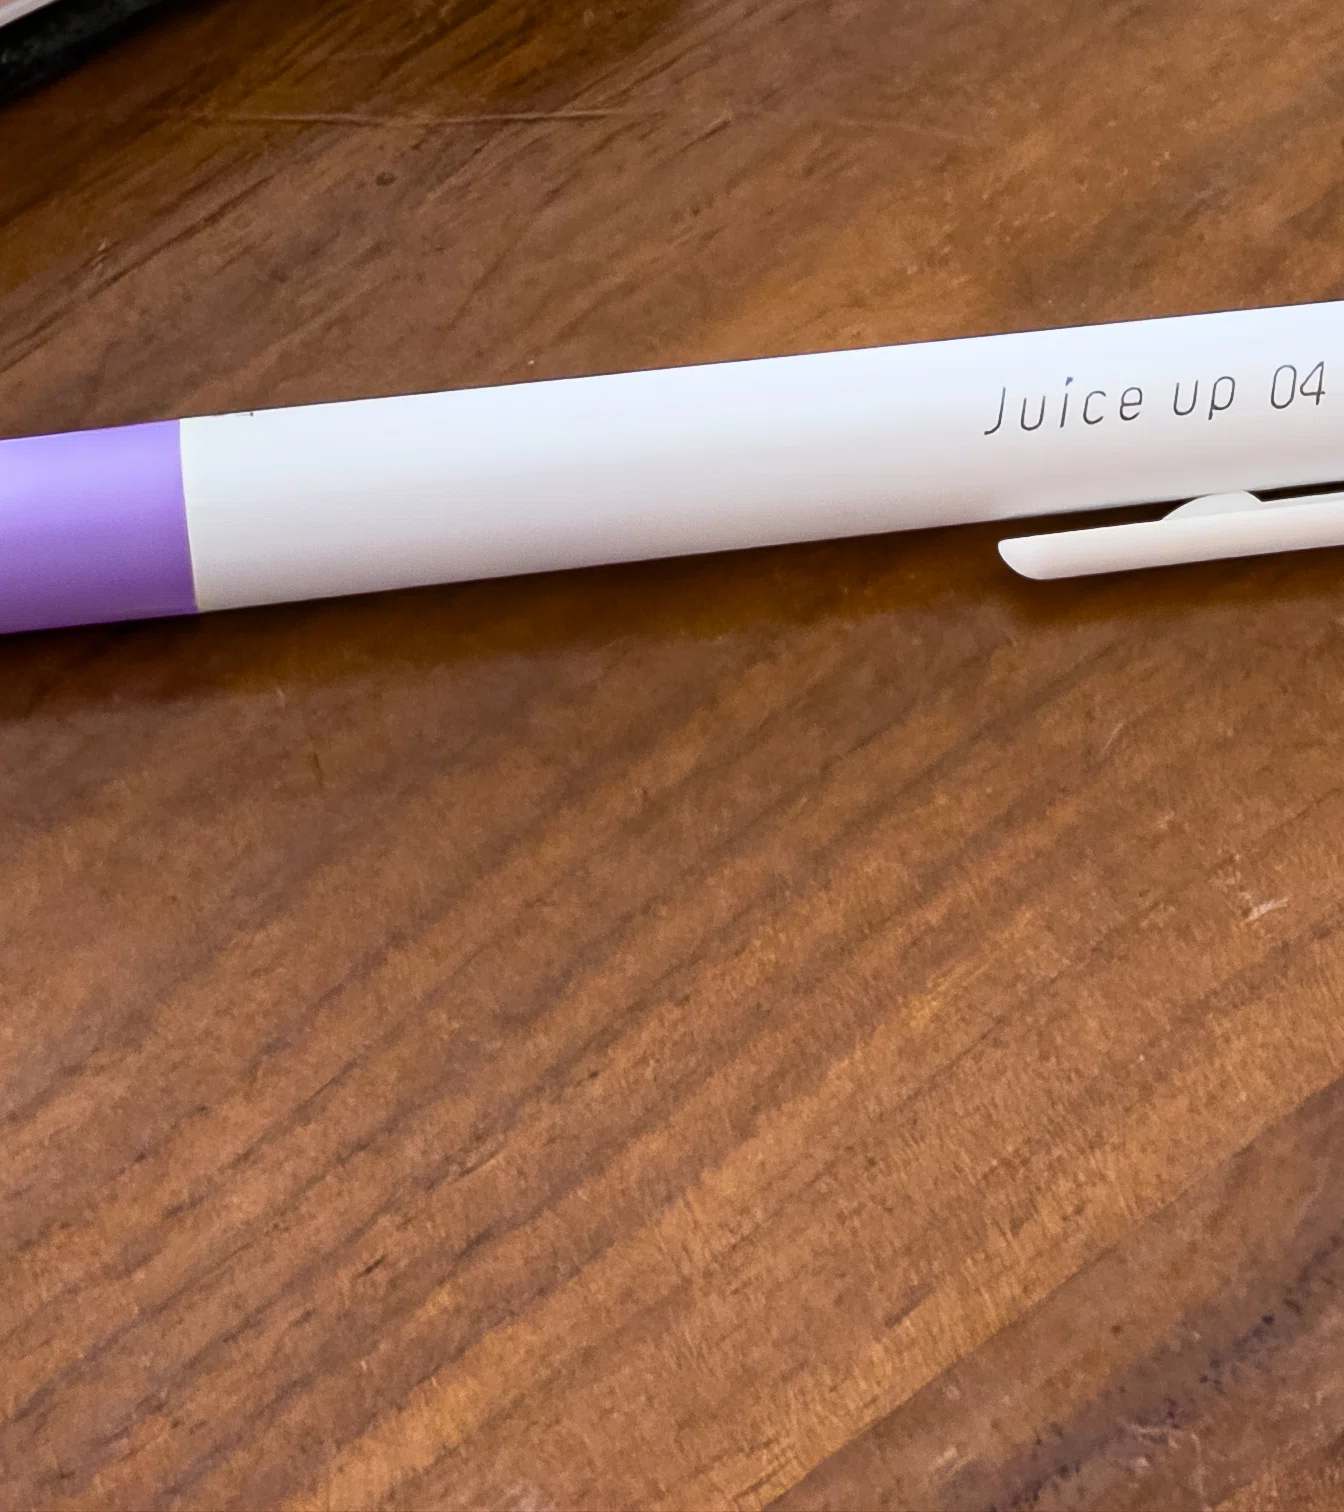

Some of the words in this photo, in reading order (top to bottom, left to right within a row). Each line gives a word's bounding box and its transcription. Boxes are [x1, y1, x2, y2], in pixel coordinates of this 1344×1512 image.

[983, 375, 1145, 436] Juice
[1172, 374, 1236, 421] up
[1270, 360, 1327, 411] 04
